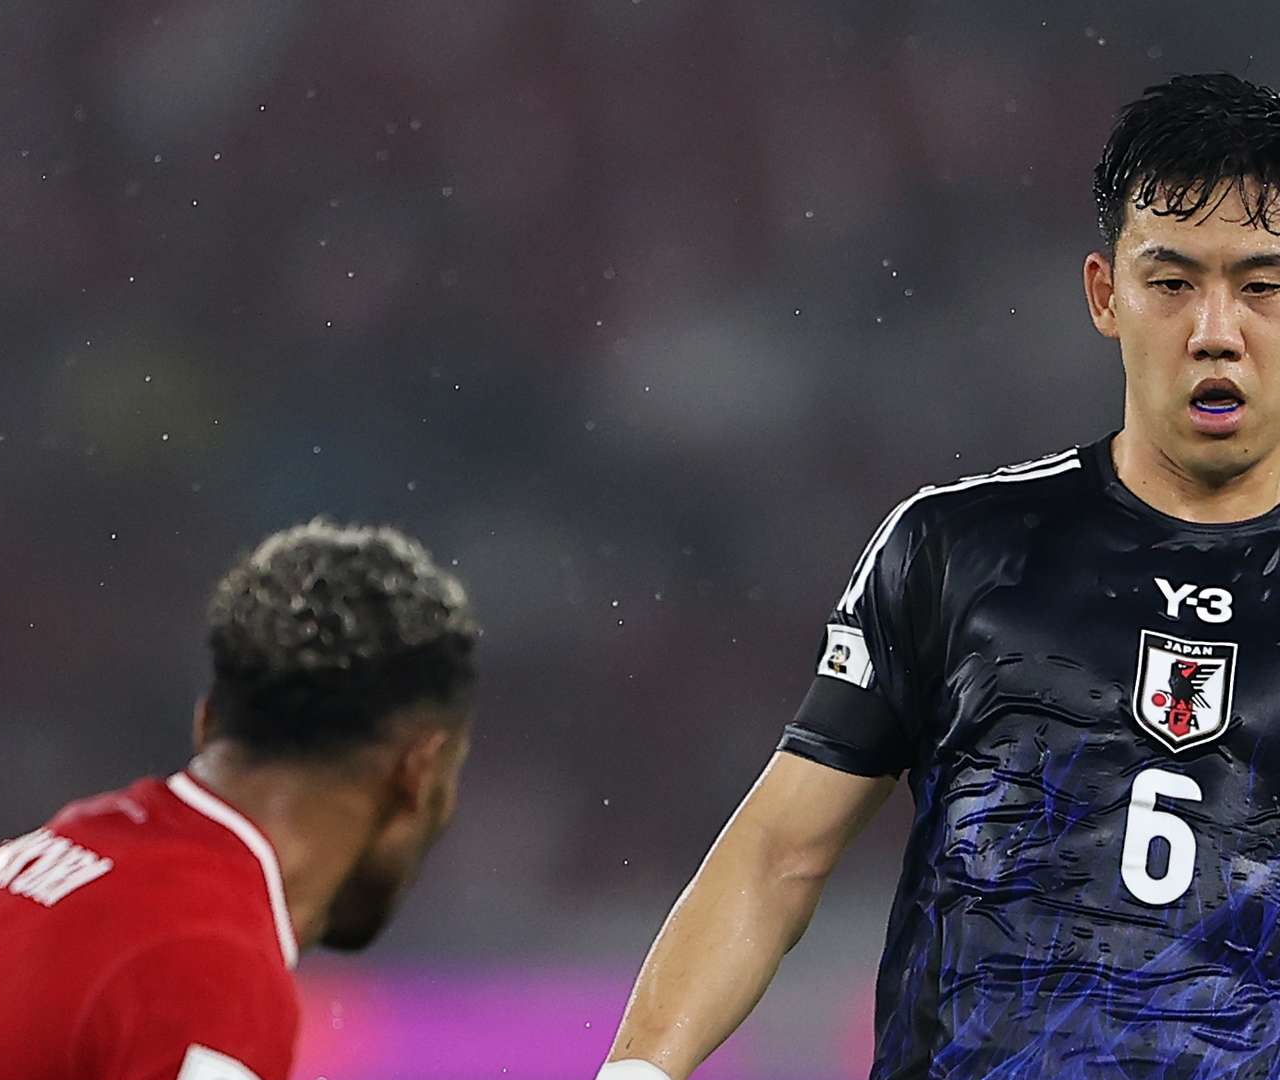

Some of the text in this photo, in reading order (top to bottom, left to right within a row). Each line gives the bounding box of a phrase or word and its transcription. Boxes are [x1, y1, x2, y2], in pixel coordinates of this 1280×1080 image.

[1154, 577, 1233, 623] Y-3
[1164, 640, 1213, 656] JAPAN
[1158, 709, 1200, 731] JFA
[1121, 768, 1202, 905] 6
